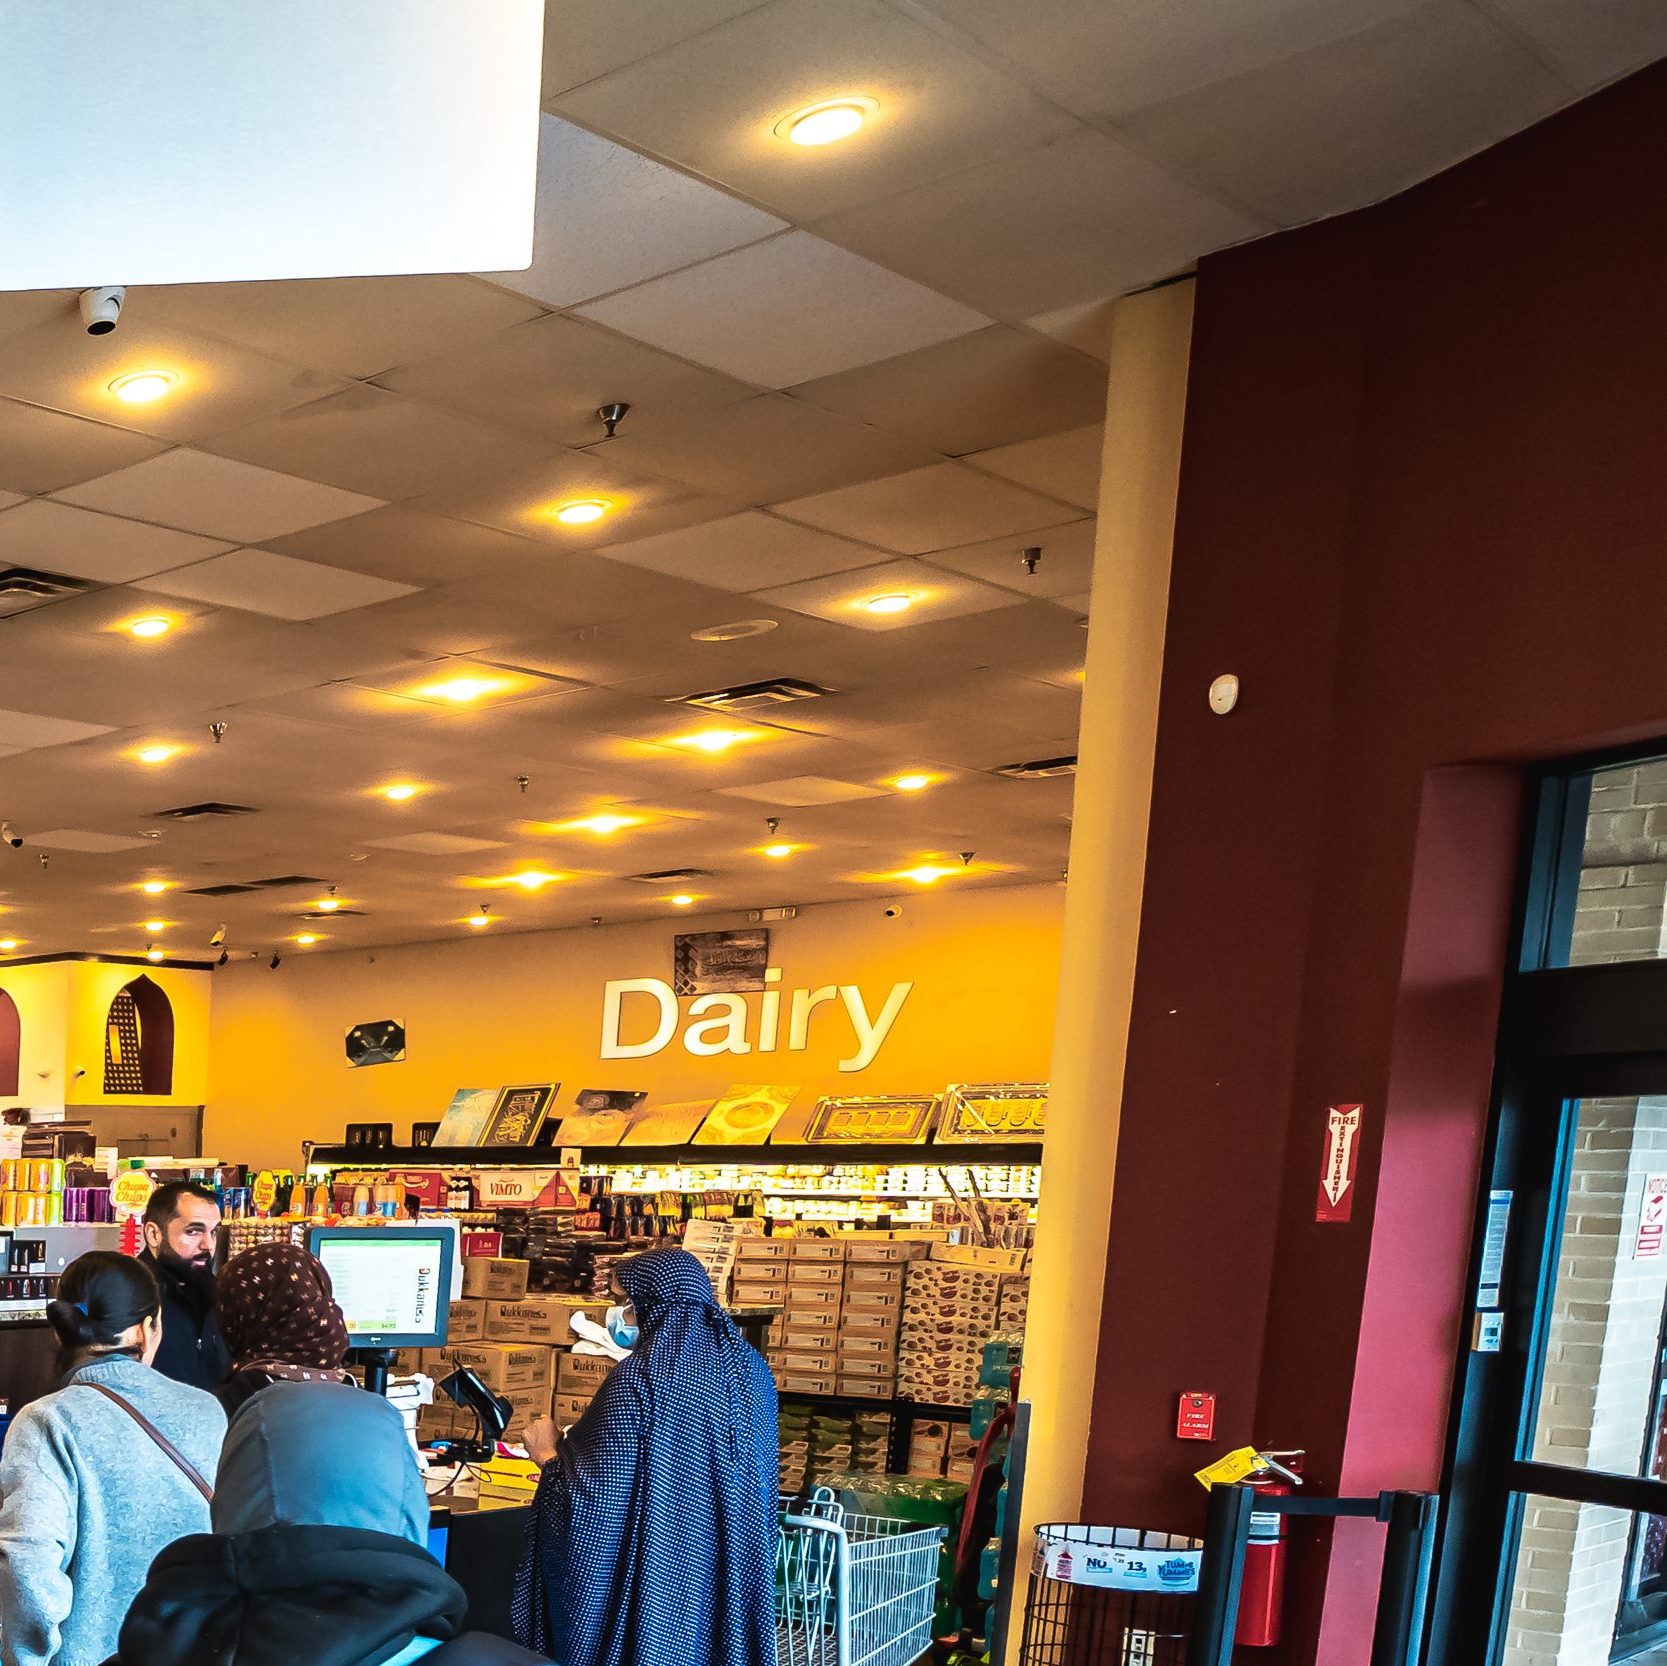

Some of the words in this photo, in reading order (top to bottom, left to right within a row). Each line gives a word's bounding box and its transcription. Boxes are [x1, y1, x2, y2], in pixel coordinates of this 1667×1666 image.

[599, 967, 915, 1073] Dairy
[1331, 1116, 1357, 1126] FIRE
[490, 1182, 522, 1196] VIMTO
